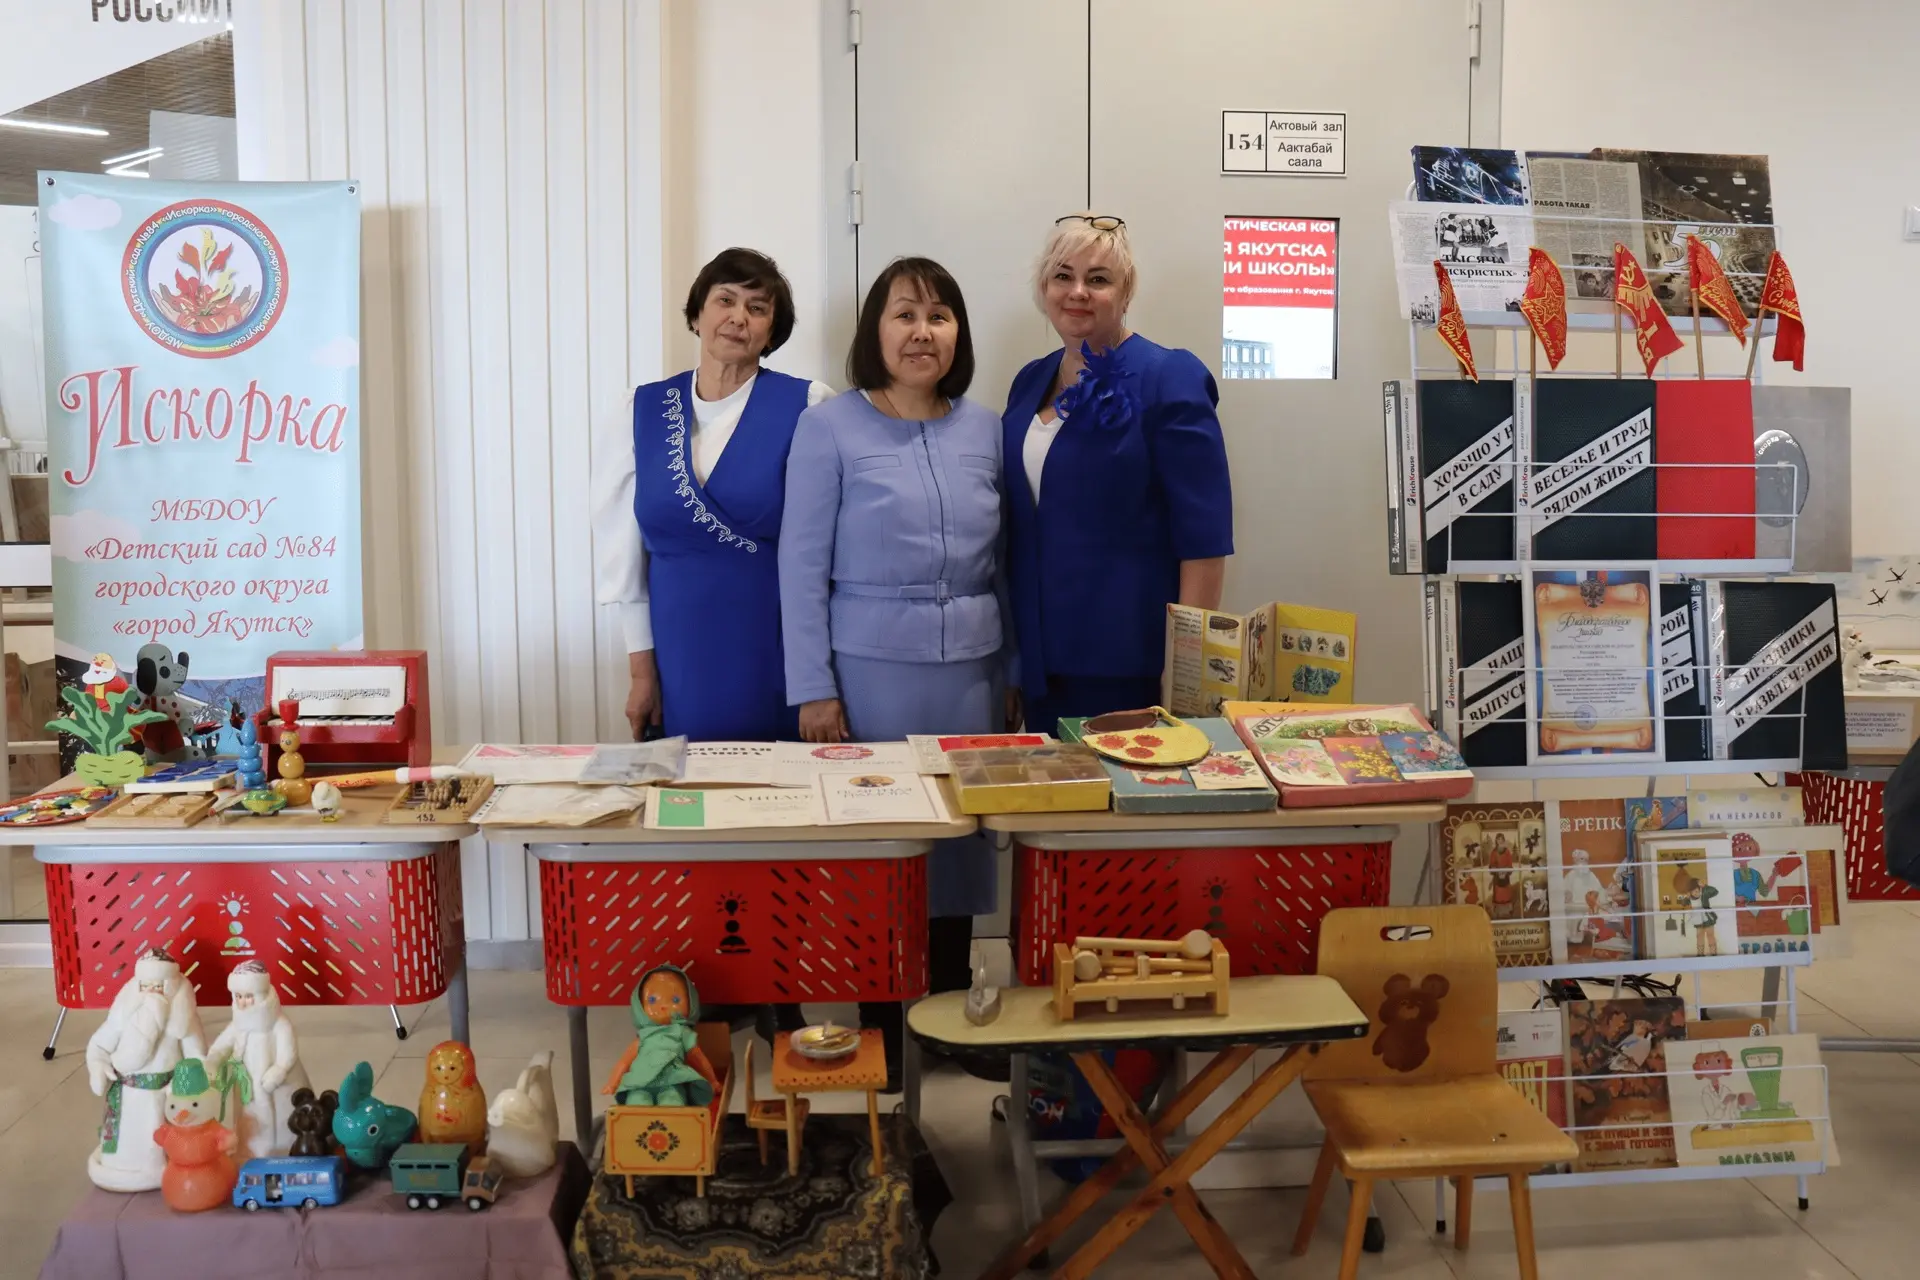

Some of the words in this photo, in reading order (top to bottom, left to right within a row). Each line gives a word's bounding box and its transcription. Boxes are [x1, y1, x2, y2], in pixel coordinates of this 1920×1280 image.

[1269, 119, 1317, 133] Актовый
[1323, 121, 1343, 133] зал
[1226, 133, 1265, 151] 154
[1277, 141, 1333, 155] Аактабай
[1288, 157, 1323, 168] саала
[161, 205, 218, 222] «Искорка»
[1565, 201, 1590, 209] ТАКАЯ
[137, 220, 160, 245] №84
[221, 209, 271, 247] городского
[131, 246, 143, 265] сад
[1238, 242, 1327, 257] ЯКУТСКА
[268, 248, 282, 283] округа
[1442, 255, 1505, 264] ТЫСЯЧА
[1248, 262, 1335, 276] ШКОЛЫ»
[1237, 285, 1293, 295] образования
[146, 321, 184, 349] МБДОУ
[60, 365, 347, 486] Искорка
[1433, 443, 1492, 492] ХОРОШО
[1493, 433, 1505, 448] У
[1533, 449, 1598, 496] ВЕСЕЛЬЕ
[1598, 439, 1611, 457] И
[1612, 416, 1650, 449] ТРУД
[1458, 492, 1469, 508] В
[1469, 465, 1504, 498] САДУ
[1542, 486, 1593, 521] РЯДОМ
[1593, 450, 1644, 490] ЖИВУТ
[150, 497, 278, 524] МБДОУ
[84, 537, 219, 564] «Детский
[227, 533, 268, 560] сад
[275, 535, 337, 559] №84
[95, 572, 236, 605] городского
[244, 576, 329, 602] округа
[112, 609, 196, 642] «город
[194, 611, 314, 640] Якутск»
[1573, 816, 1625, 832] РЕПК
[1727, 811, 1782, 820] НЕКРАСОВ
[1738, 938, 1810, 955] ТРОЙКА
[1532, 1032, 1539, 1041] 11
[1719, 1151, 1796, 1165] МАГАЗИН
